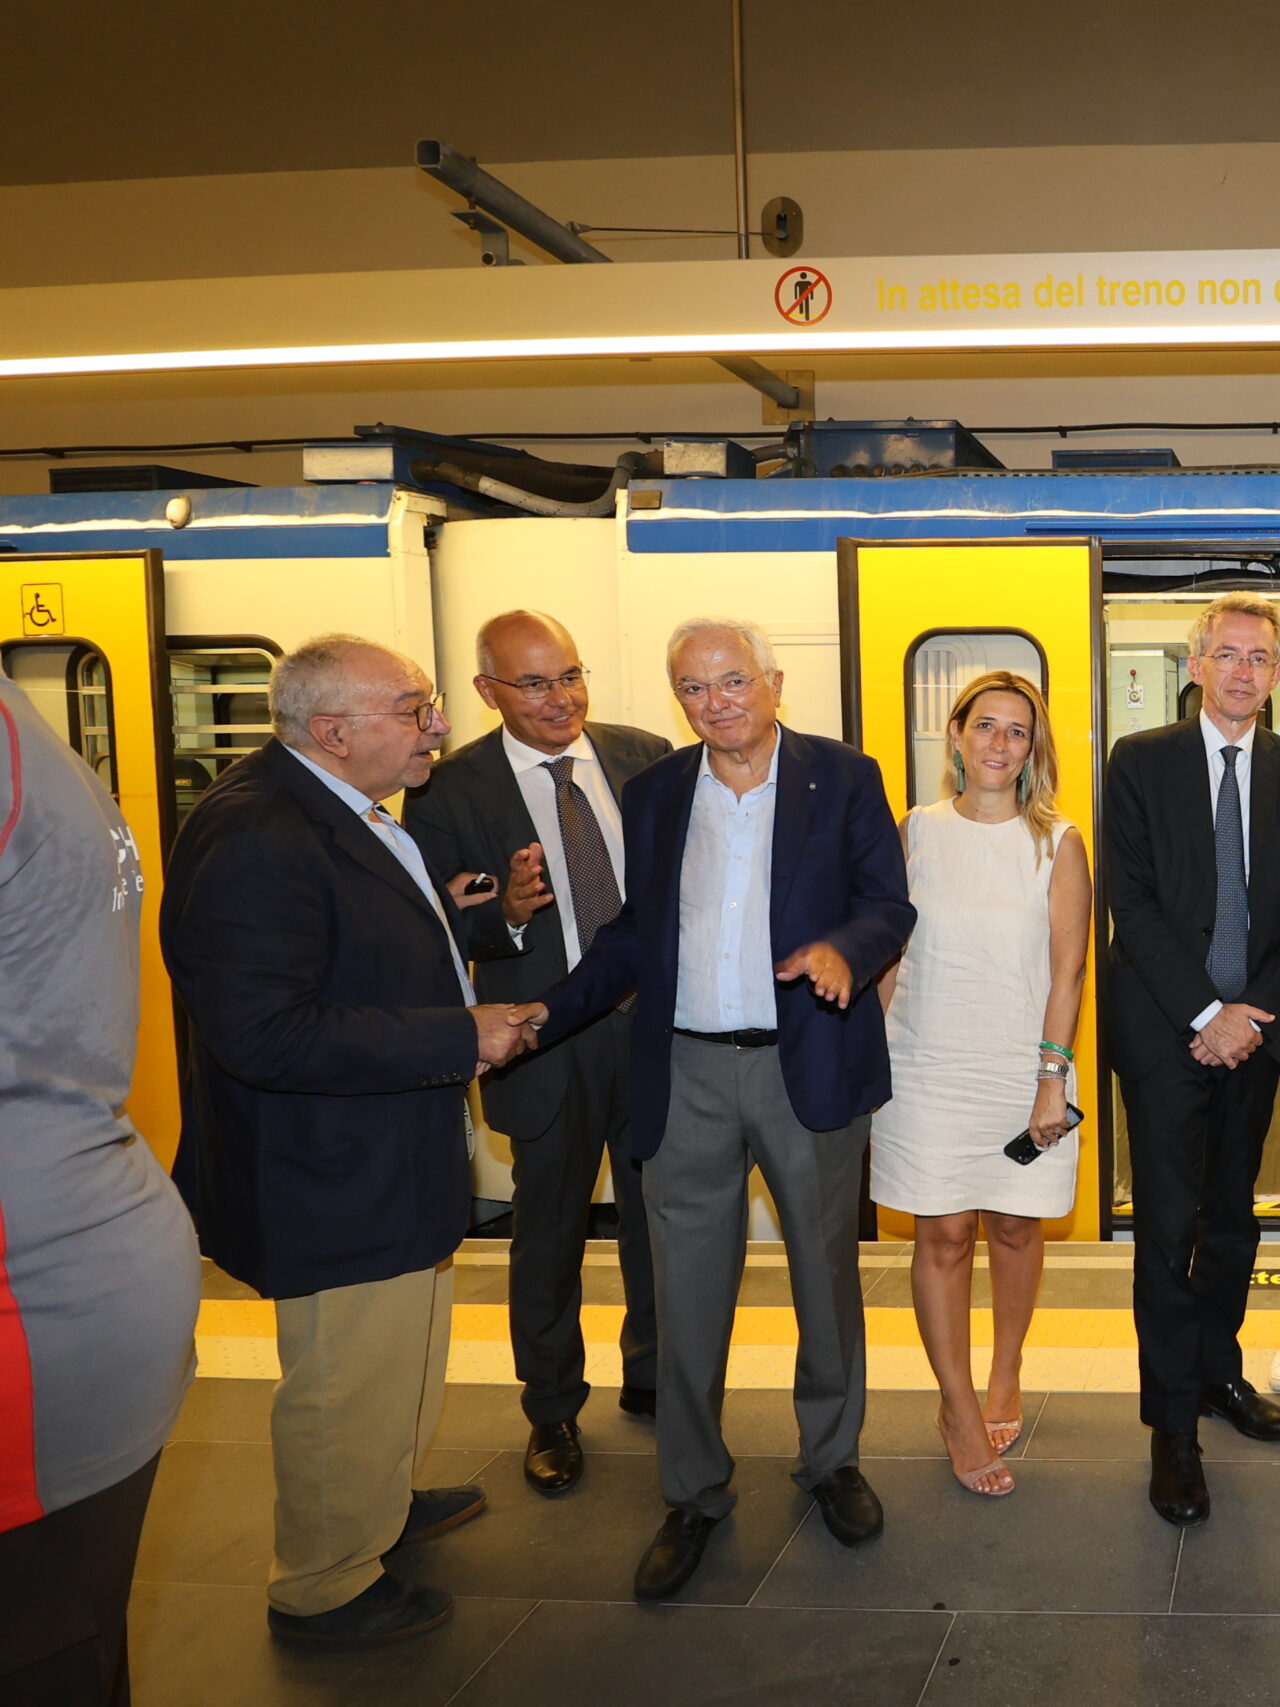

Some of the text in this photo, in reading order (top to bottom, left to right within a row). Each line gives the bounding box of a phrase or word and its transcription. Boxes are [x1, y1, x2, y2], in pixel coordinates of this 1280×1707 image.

[876, 277, 908, 311] In
[917, 277, 1022, 311] attesa
[1032, 272, 1085, 308] del
[1095, 274, 1186, 307] treno
[1197, 278, 1262, 305] non
